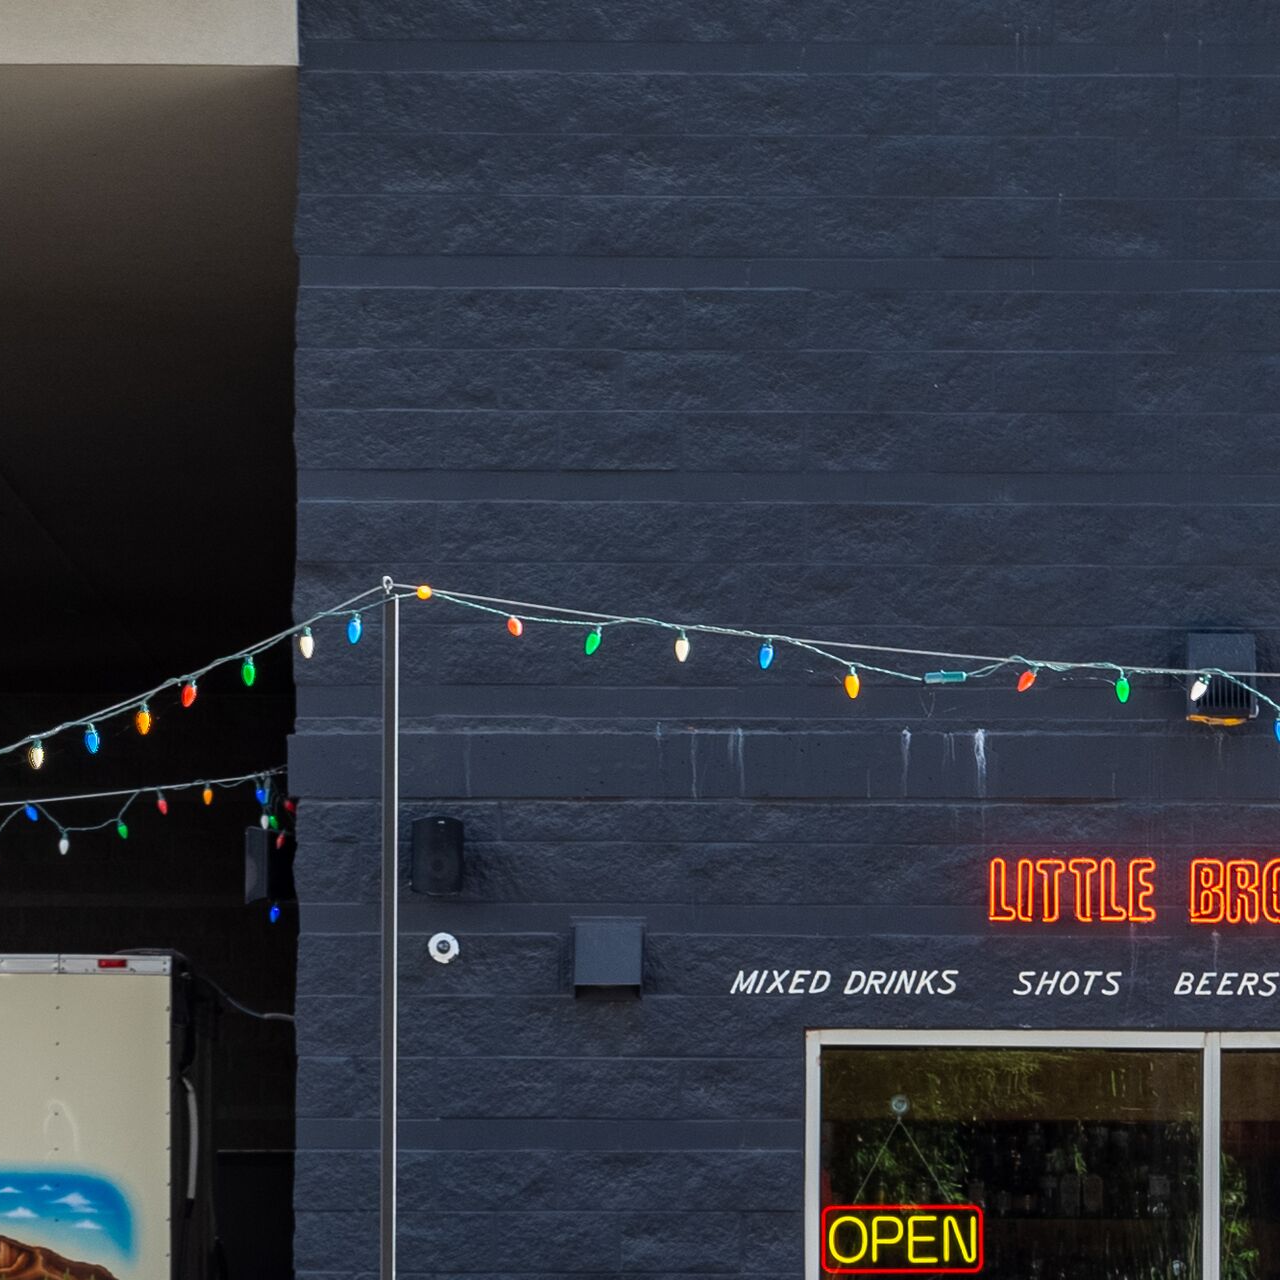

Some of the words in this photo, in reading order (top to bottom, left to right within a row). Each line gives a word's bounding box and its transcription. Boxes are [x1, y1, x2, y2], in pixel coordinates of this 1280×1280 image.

[988, 857, 1157, 923] LITTLE
[729, 969, 832, 996] MIXED
[843, 969, 959, 996] DRINKS
[1012, 970, 1123, 996] SHOTS
[1173, 970, 1280, 997] BEERS
[828, 1215, 977, 1264] OPEN
